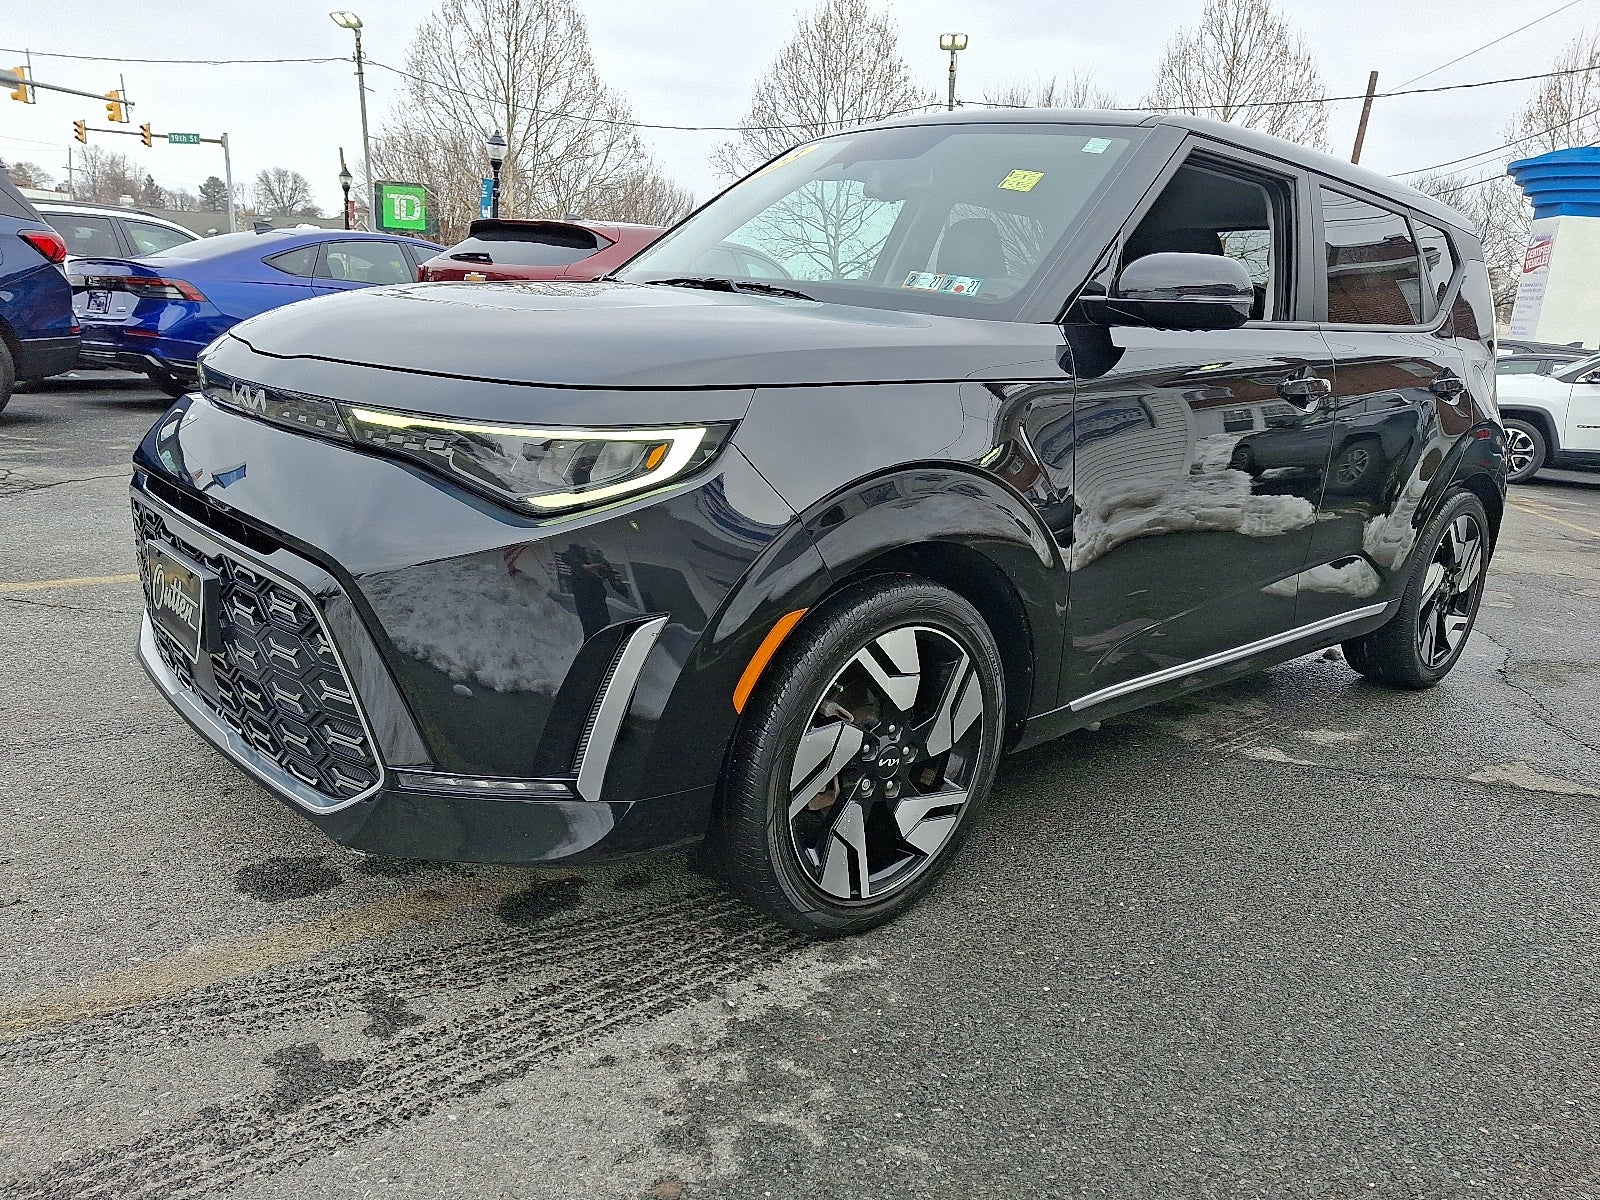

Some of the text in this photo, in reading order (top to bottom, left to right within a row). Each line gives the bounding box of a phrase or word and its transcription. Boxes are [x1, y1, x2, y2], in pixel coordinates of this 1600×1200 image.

[171, 134, 198, 143] 19th St
[387, 193, 421, 220] TD
[1525, 255, 1550, 270] VEHICLES
[907, 276, 917, 287] 2
[929, 276, 943, 288] 27
[944, 279, 954, 291] 2
[967, 281, 980, 293] 27
[231, 381, 267, 412] KIA
[152, 563, 198, 632] Outten
